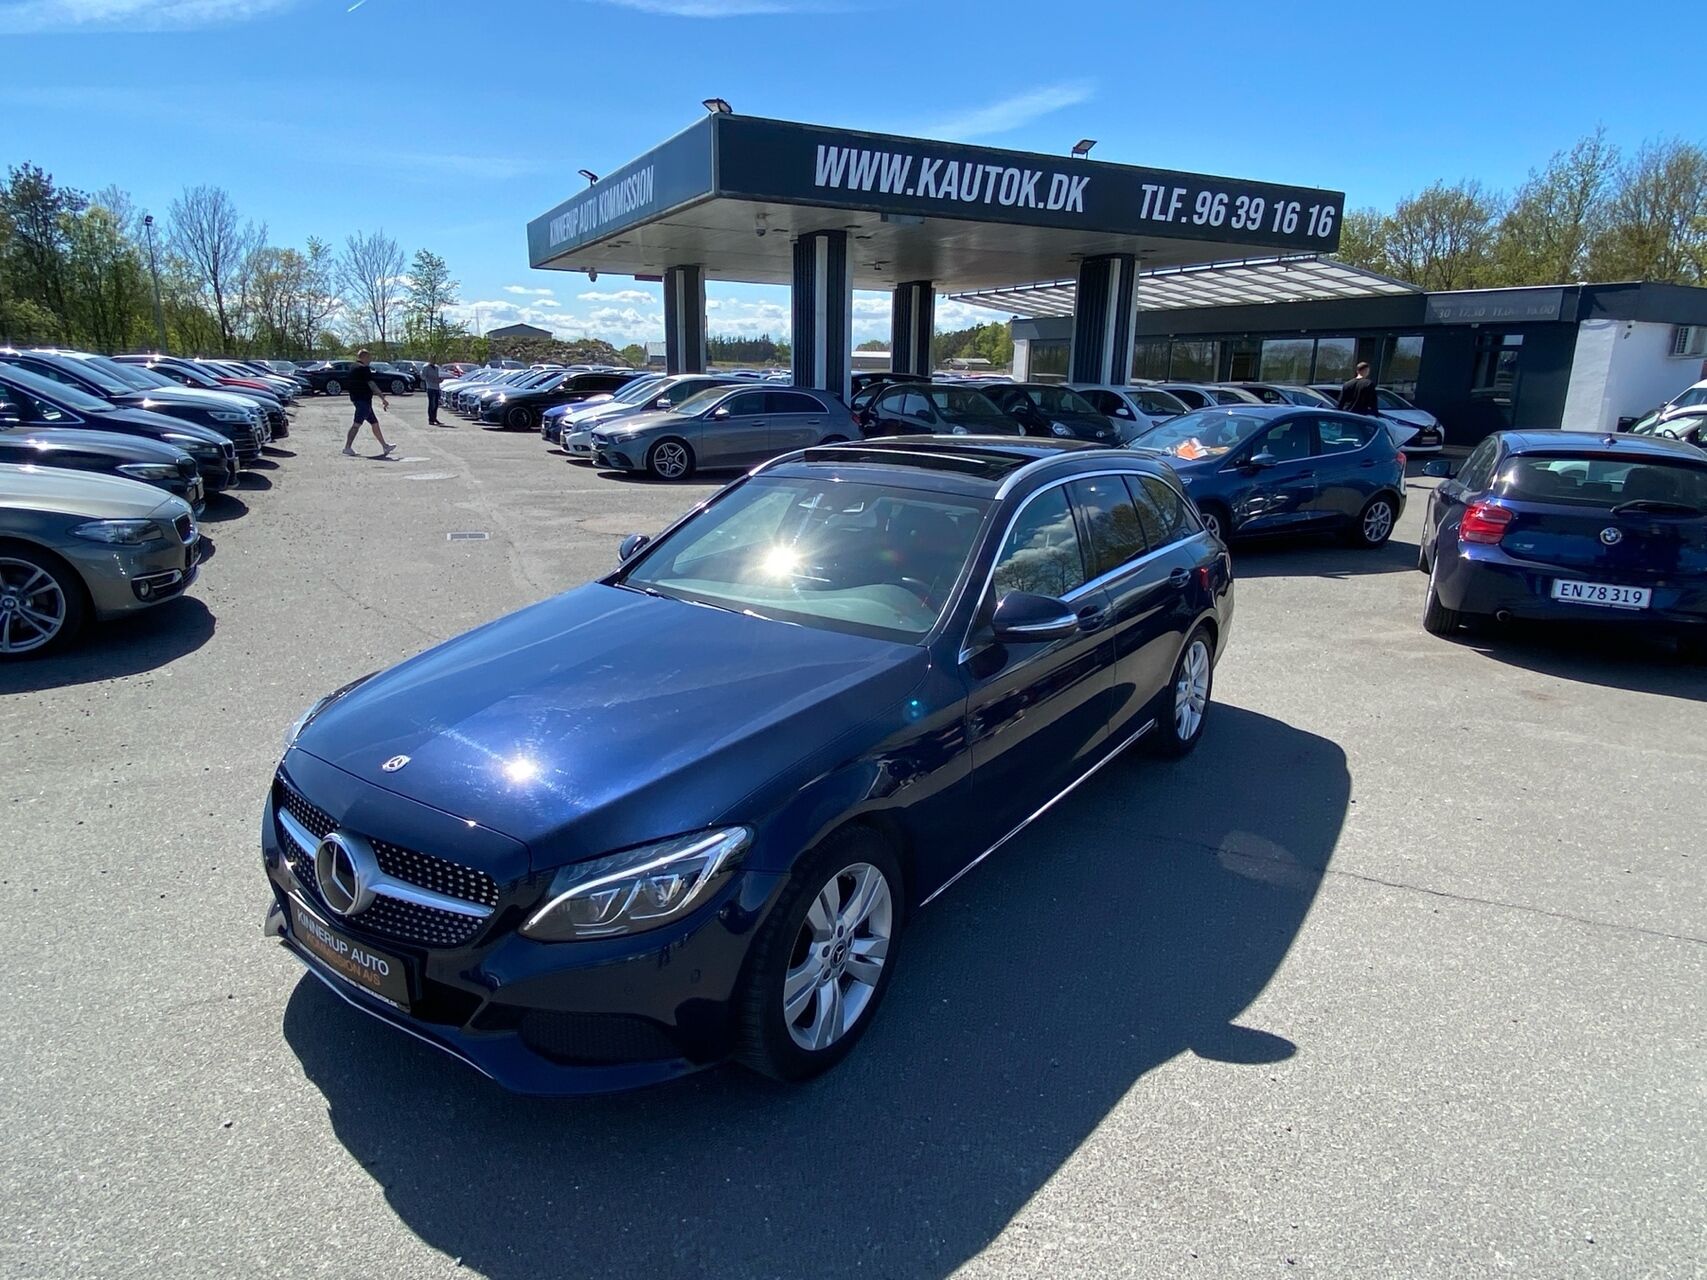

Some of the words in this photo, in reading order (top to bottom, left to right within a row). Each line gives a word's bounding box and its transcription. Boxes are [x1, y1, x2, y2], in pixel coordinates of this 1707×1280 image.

[578, 196, 598, 234] AUTO
[599, 164, 654, 225] KOMMISSION
[814, 144, 1090, 214] WWW.KAUTOK.DK
[1139, 183, 1187, 224] TLF.
[1193, 190, 1226, 227] 96
[1231, 194, 1265, 232] 39
[1272, 200, 1299, 235] 16
[1307, 204, 1336, 239] 16
[1560, 583, 1582, 598] EN
[1587, 585, 1606, 600] 78
[1611, 588, 1642, 604] 319
[297, 909, 348, 954] KINNERUP
[351, 948, 389, 976] AUTO
[363, 969, 381, 985] A/S
